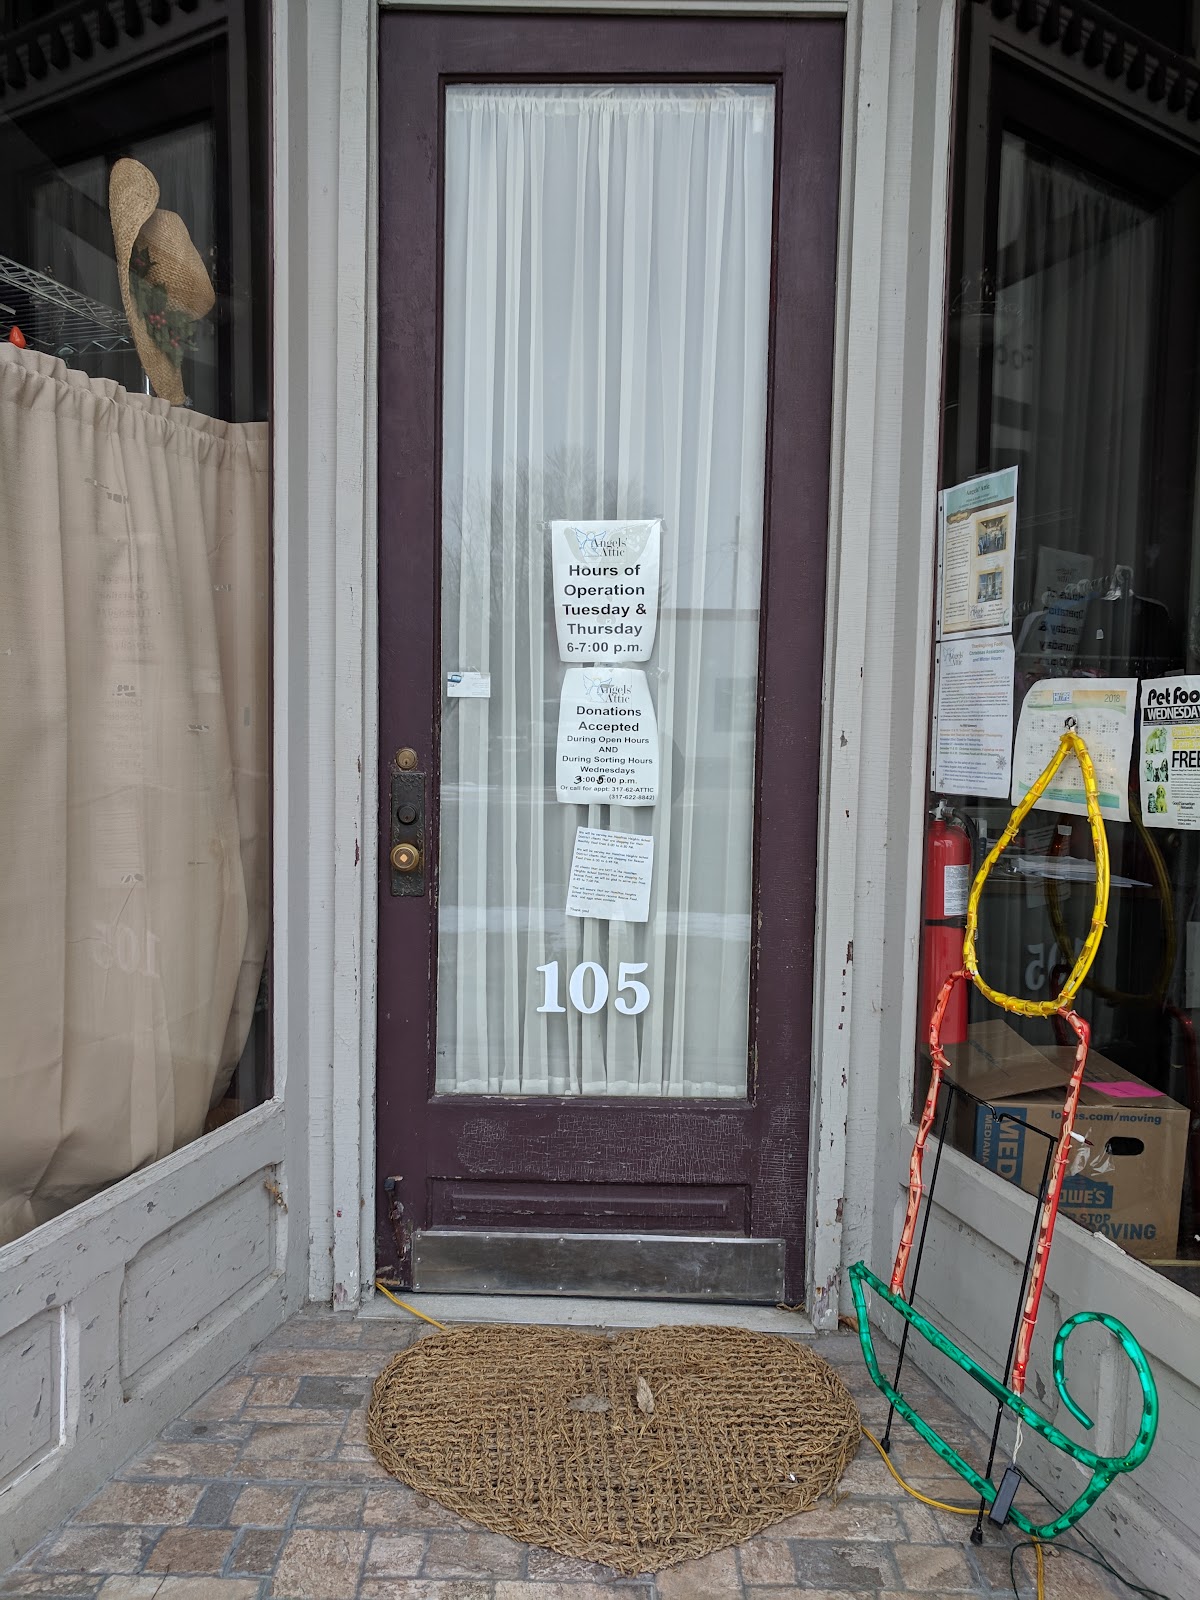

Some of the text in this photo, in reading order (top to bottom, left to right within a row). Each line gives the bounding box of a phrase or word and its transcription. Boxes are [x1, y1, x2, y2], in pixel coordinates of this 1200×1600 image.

[600, 547, 625, 556] Attic
[569, 564, 641, 576] Hours of
[564, 584, 645, 598] Operation
[562, 604, 646, 618] Tuesday &
[567, 623, 642, 637] Thursday
[567, 642, 643, 654] 6-7:00 p.m.
[1104, 694, 1120, 702] 2018
[1148, 688, 1170, 706] Pet
[576, 706, 642, 716] Donations
[578, 722, 639, 733] Accepted
[567, 735, 596, 744] During
[562, 755, 591, 764] During
[594, 756, 626, 765] Sorting
[580, 766, 635, 775] Wednesdays
[536, 961, 650, 1015] 105
[1051, 1110, 1162, 1125] loes.com/moving
[982, 1114, 993, 1163] MEDIANA
[997, 1115, 1021, 1180] MED
[1057, 1188, 1105, 1204] OWE'S
[1080, 1213, 1111, 1225] STOP
[1091, 1223, 1157, 1240] OVING
